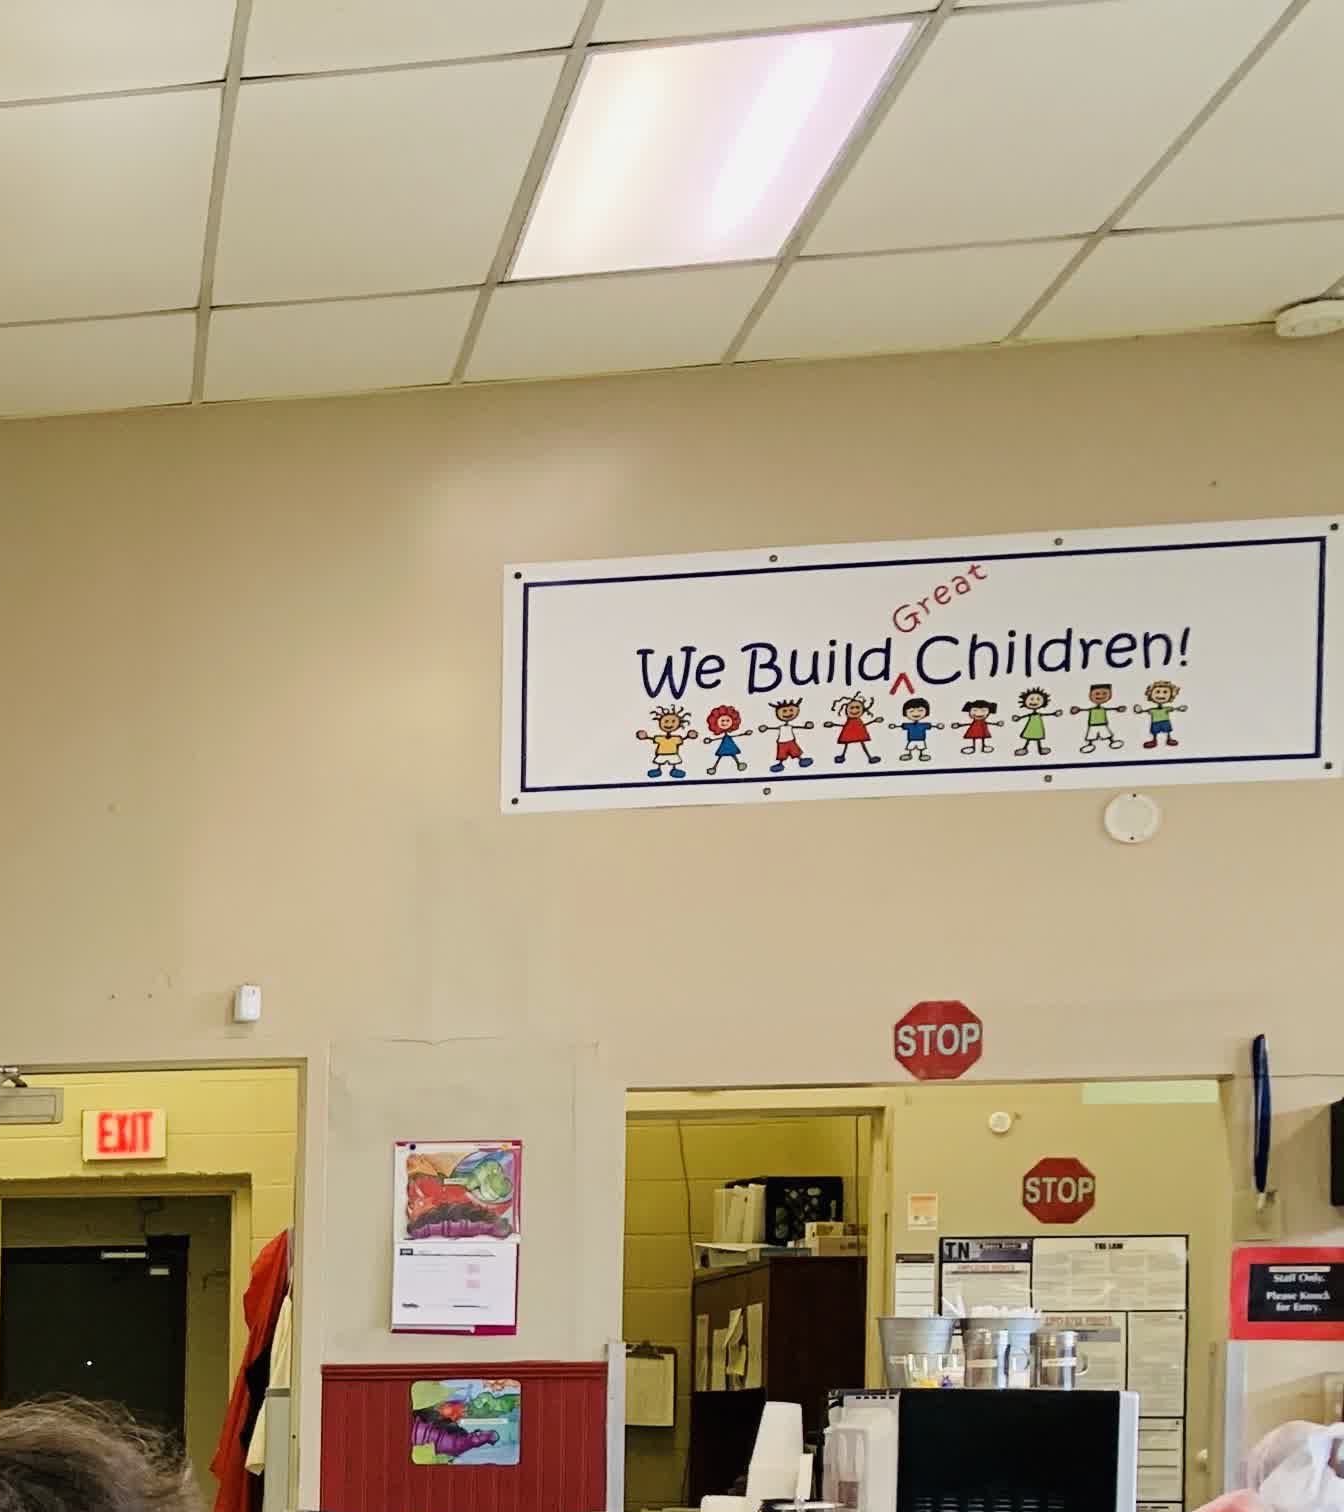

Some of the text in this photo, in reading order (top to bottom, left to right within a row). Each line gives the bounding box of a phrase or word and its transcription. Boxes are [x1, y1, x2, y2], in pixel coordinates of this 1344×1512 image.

[892, 563, 989, 633] Great
[636, 626, 1191, 700] We Build Children!
[897, 1022, 981, 1057] STOP
[97, 1111, 154, 1153] EXIT
[1024, 1176, 1095, 1204] STOP
[944, 1241, 970, 1260] TN
